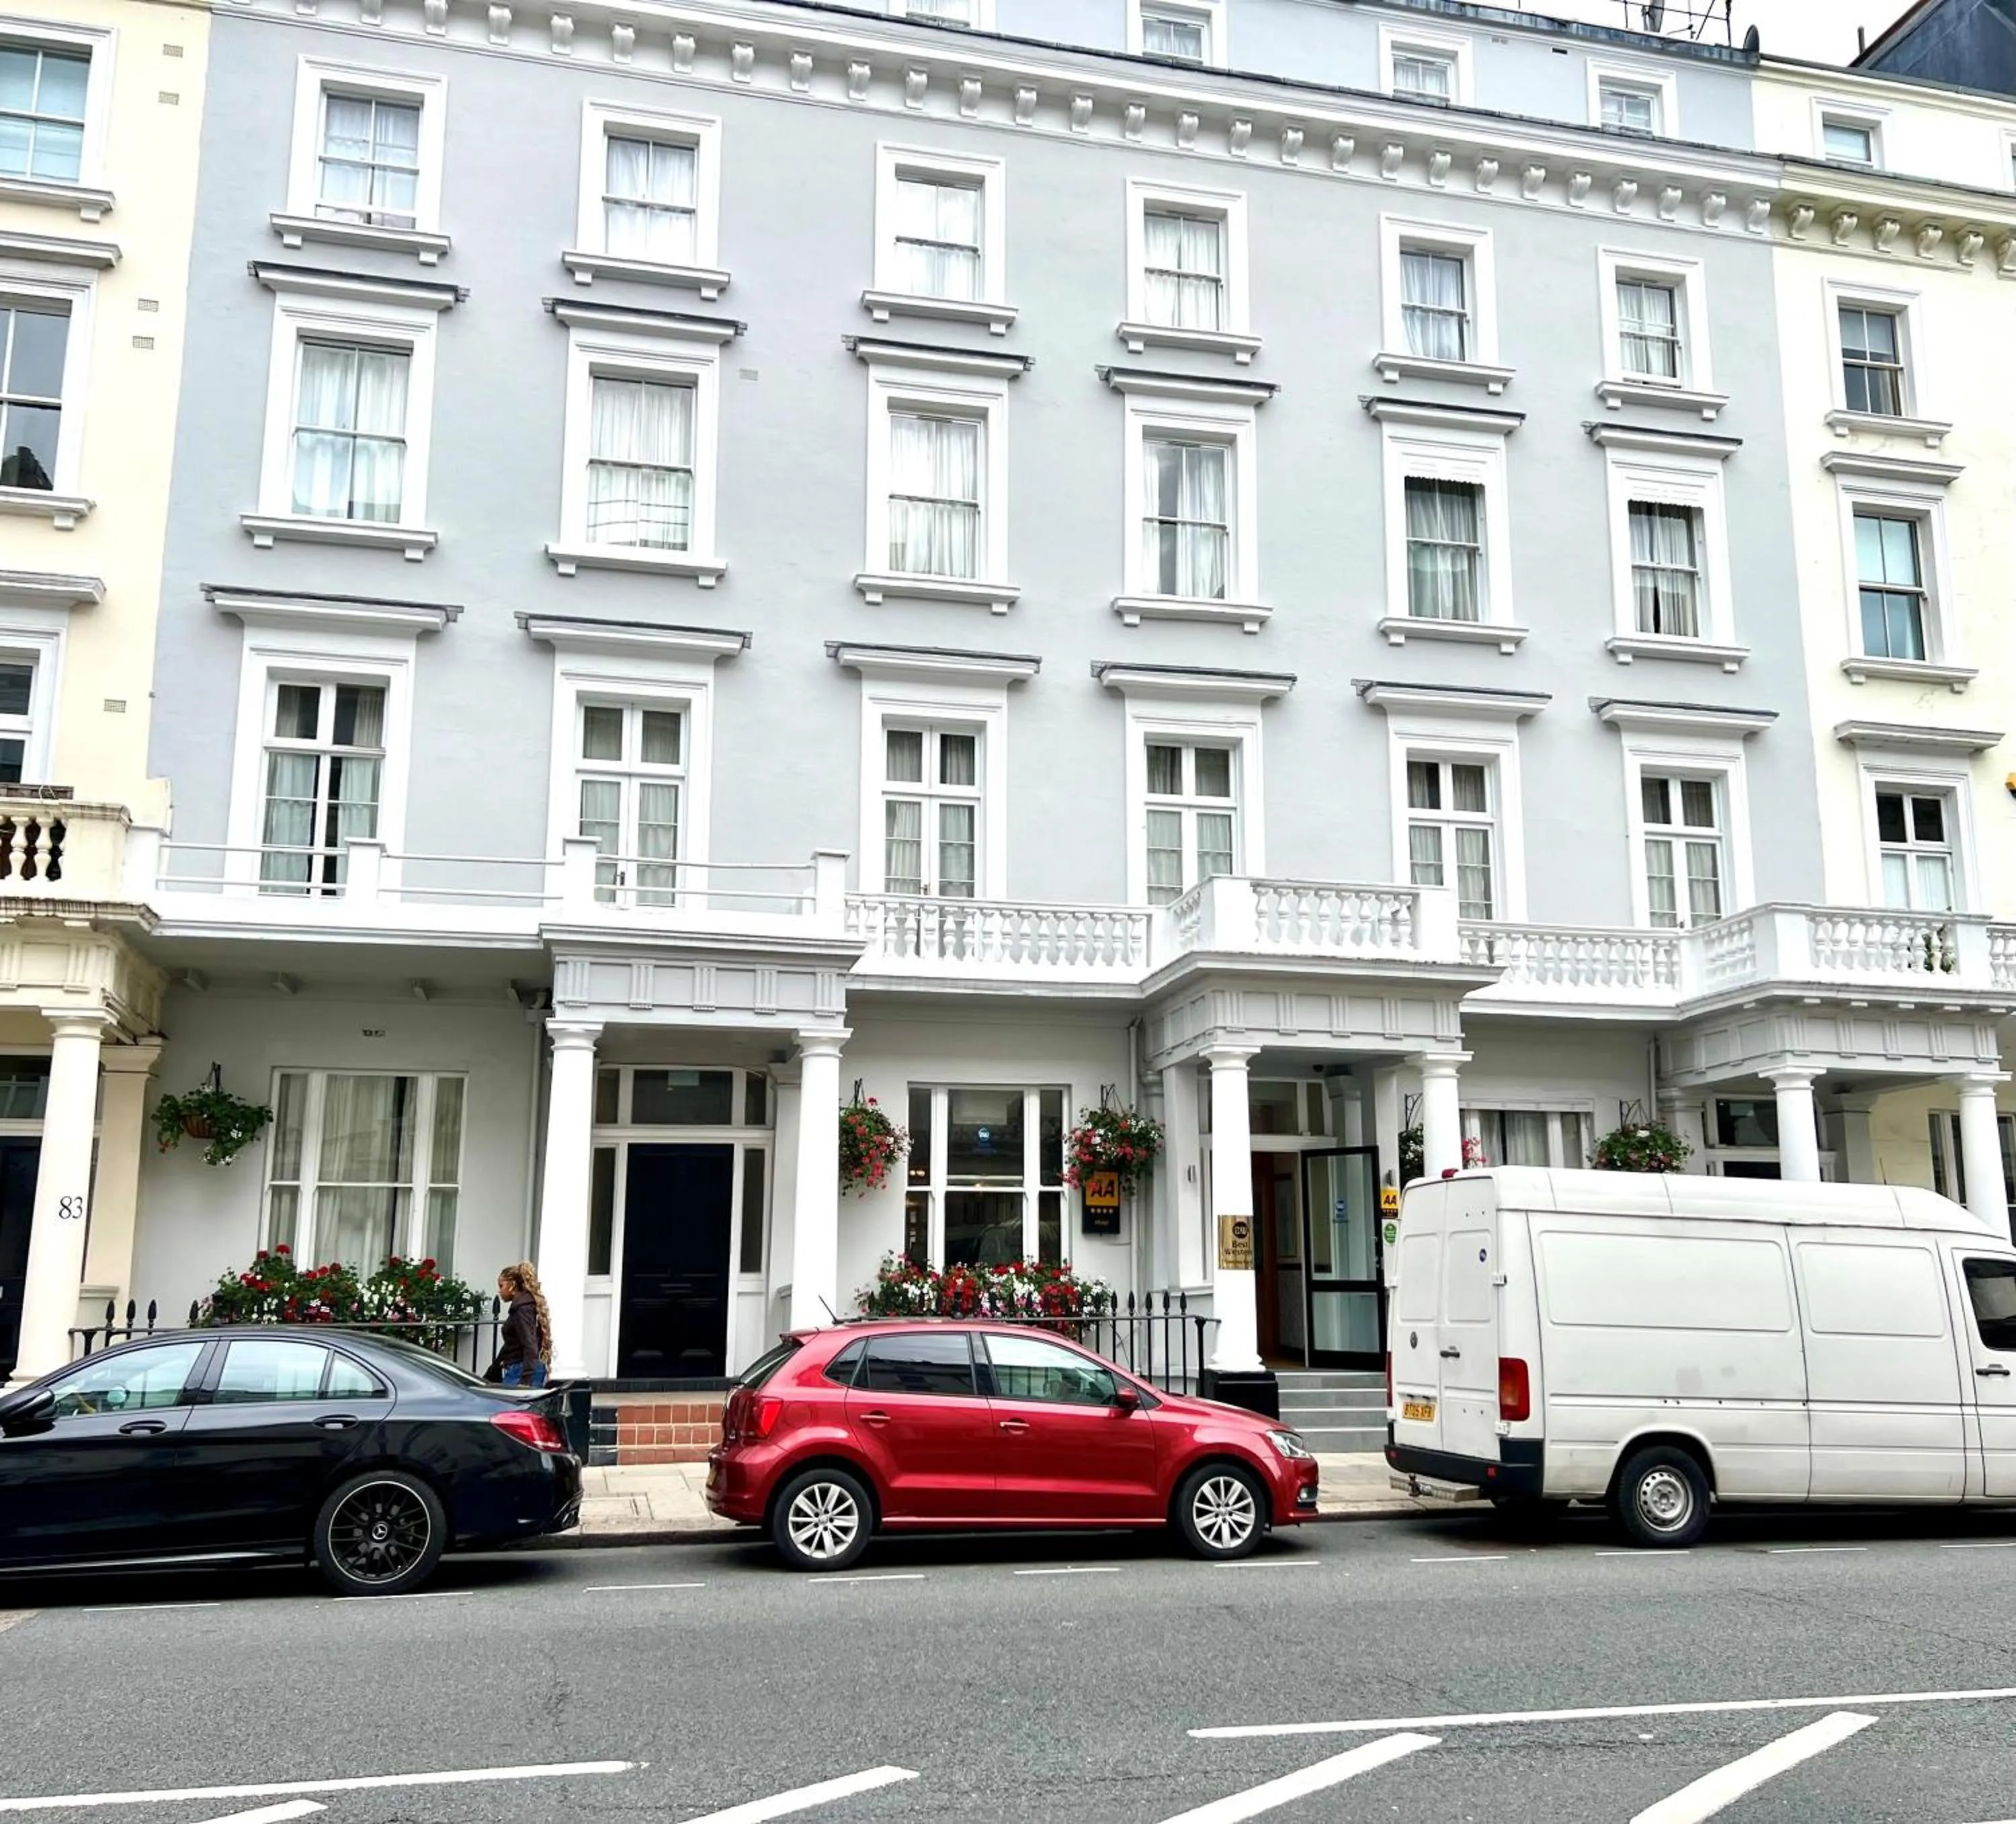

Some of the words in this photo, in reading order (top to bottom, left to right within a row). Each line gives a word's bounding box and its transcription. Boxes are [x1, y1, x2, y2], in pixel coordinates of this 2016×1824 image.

[1090, 1179, 1116, 1198] AA
[59, 1196, 82, 1219] 83
[1384, 1195, 1397, 1204] AA
